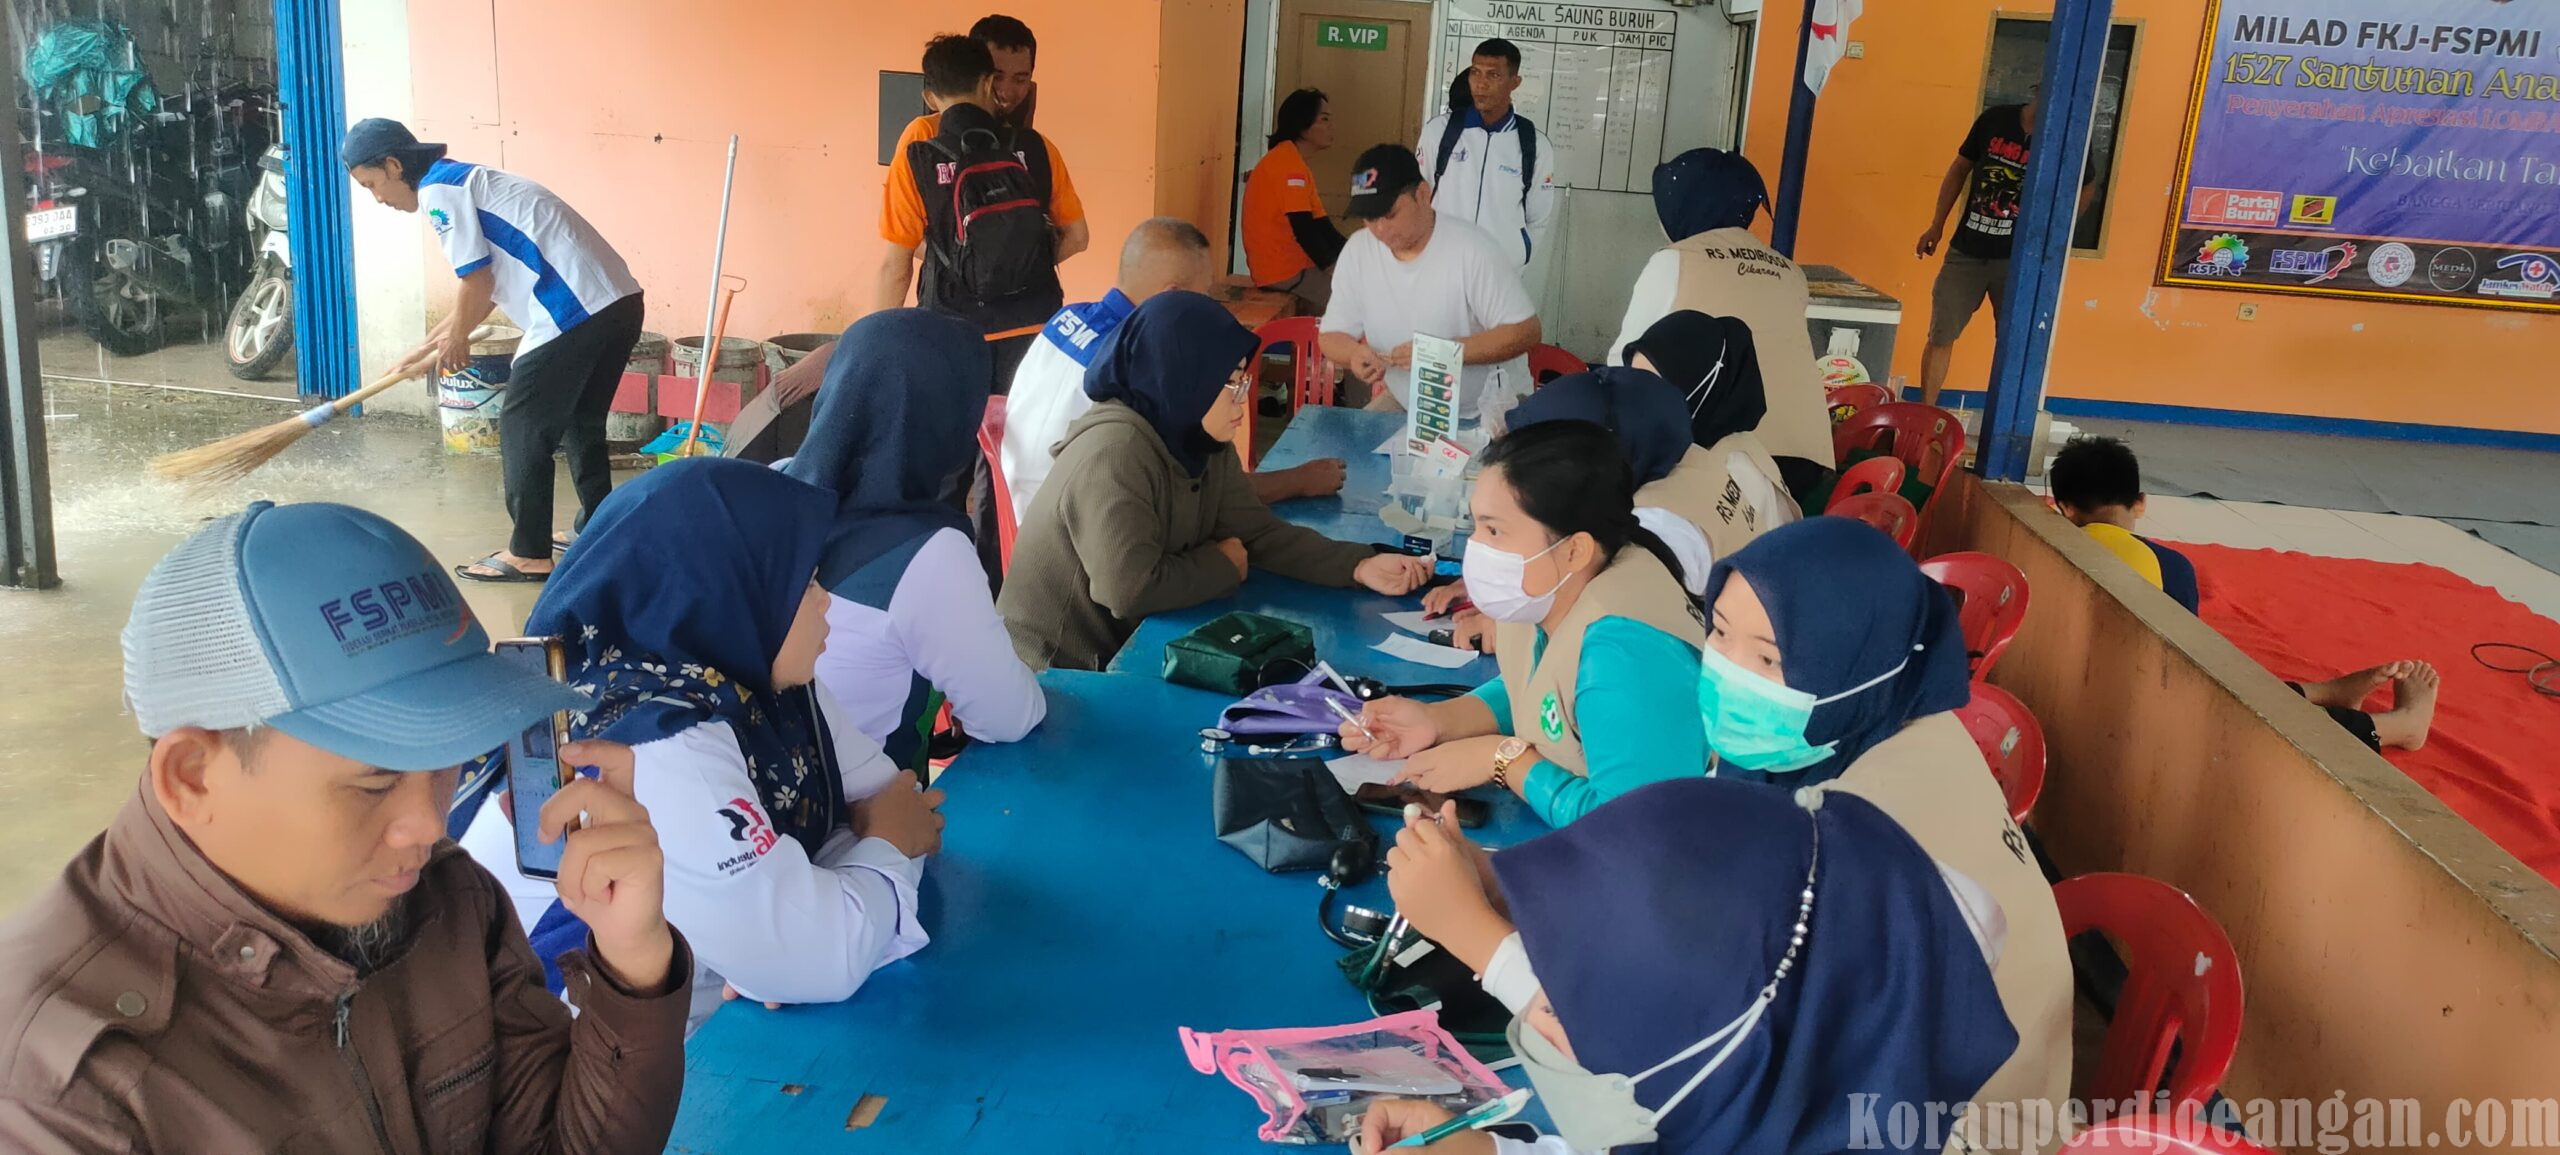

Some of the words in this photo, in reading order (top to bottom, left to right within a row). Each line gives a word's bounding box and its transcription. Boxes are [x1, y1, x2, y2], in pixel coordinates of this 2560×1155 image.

[1487, 3, 1545, 21] JADWAL
[1555, 5, 1603, 26] SAUNG
[1609, 10, 1655, 29] BURUH
[1328, 26, 1343, 42] R.
[1348, 27, 1379, 44] VIP
[1506, 27, 1545, 39] AGENDA
[1573, 31, 1598, 42] PUK
[1618, 33, 1641, 44] JAM
[1649, 35, 1667, 47] PIC
[2233, 14, 2348, 46] MILAD
[2356, 21, 2541, 58] FKJ-FSPMI
[2223, 52, 2293, 86] 1527
[2295, 56, 2473, 96] Santunan
[2226, 94, 2365, 122] Penyerahan
[2519, 156, 2560, 185] Ta
[2227, 194, 2279, 209] Partai
[2225, 207, 2276, 222] Buruh
[2188, 263, 2225, 276] KSPI
[2270, 250, 2329, 272] FSPMI
